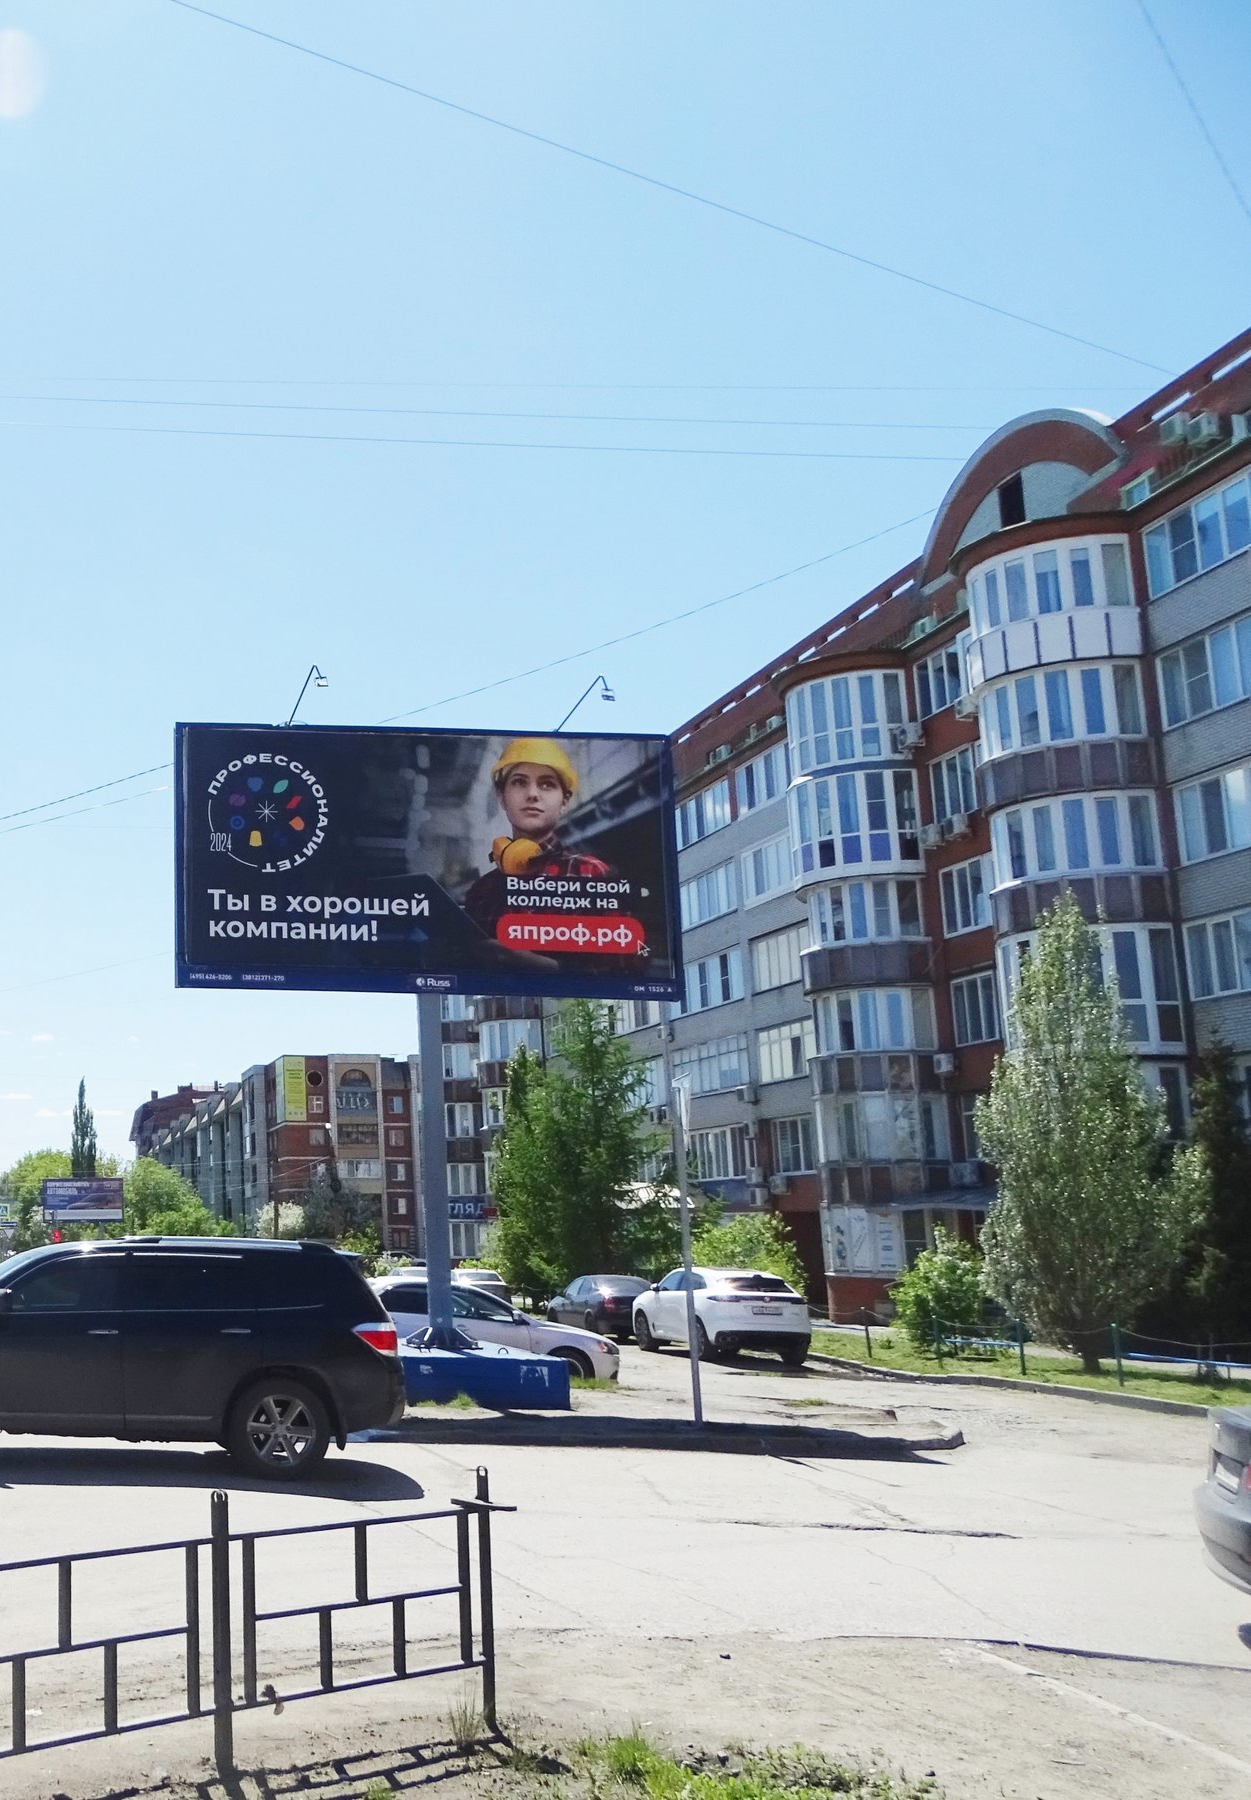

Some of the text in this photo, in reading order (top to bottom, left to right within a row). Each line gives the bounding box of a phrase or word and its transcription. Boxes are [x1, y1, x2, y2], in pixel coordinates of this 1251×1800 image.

[207, 753, 329, 873] ПРОФЕССИОНАЛИТЕТ
[210, 832, 232, 852] 2024
[506, 876, 630, 894] Выбери свой
[207, 888, 430, 919] Ты в хорошей
[507, 894, 618, 910] колледж на
[209, 920, 378, 942] компании!
[507, 922, 633, 947] япроф.рф
[427, 977, 451, 987] Russ
